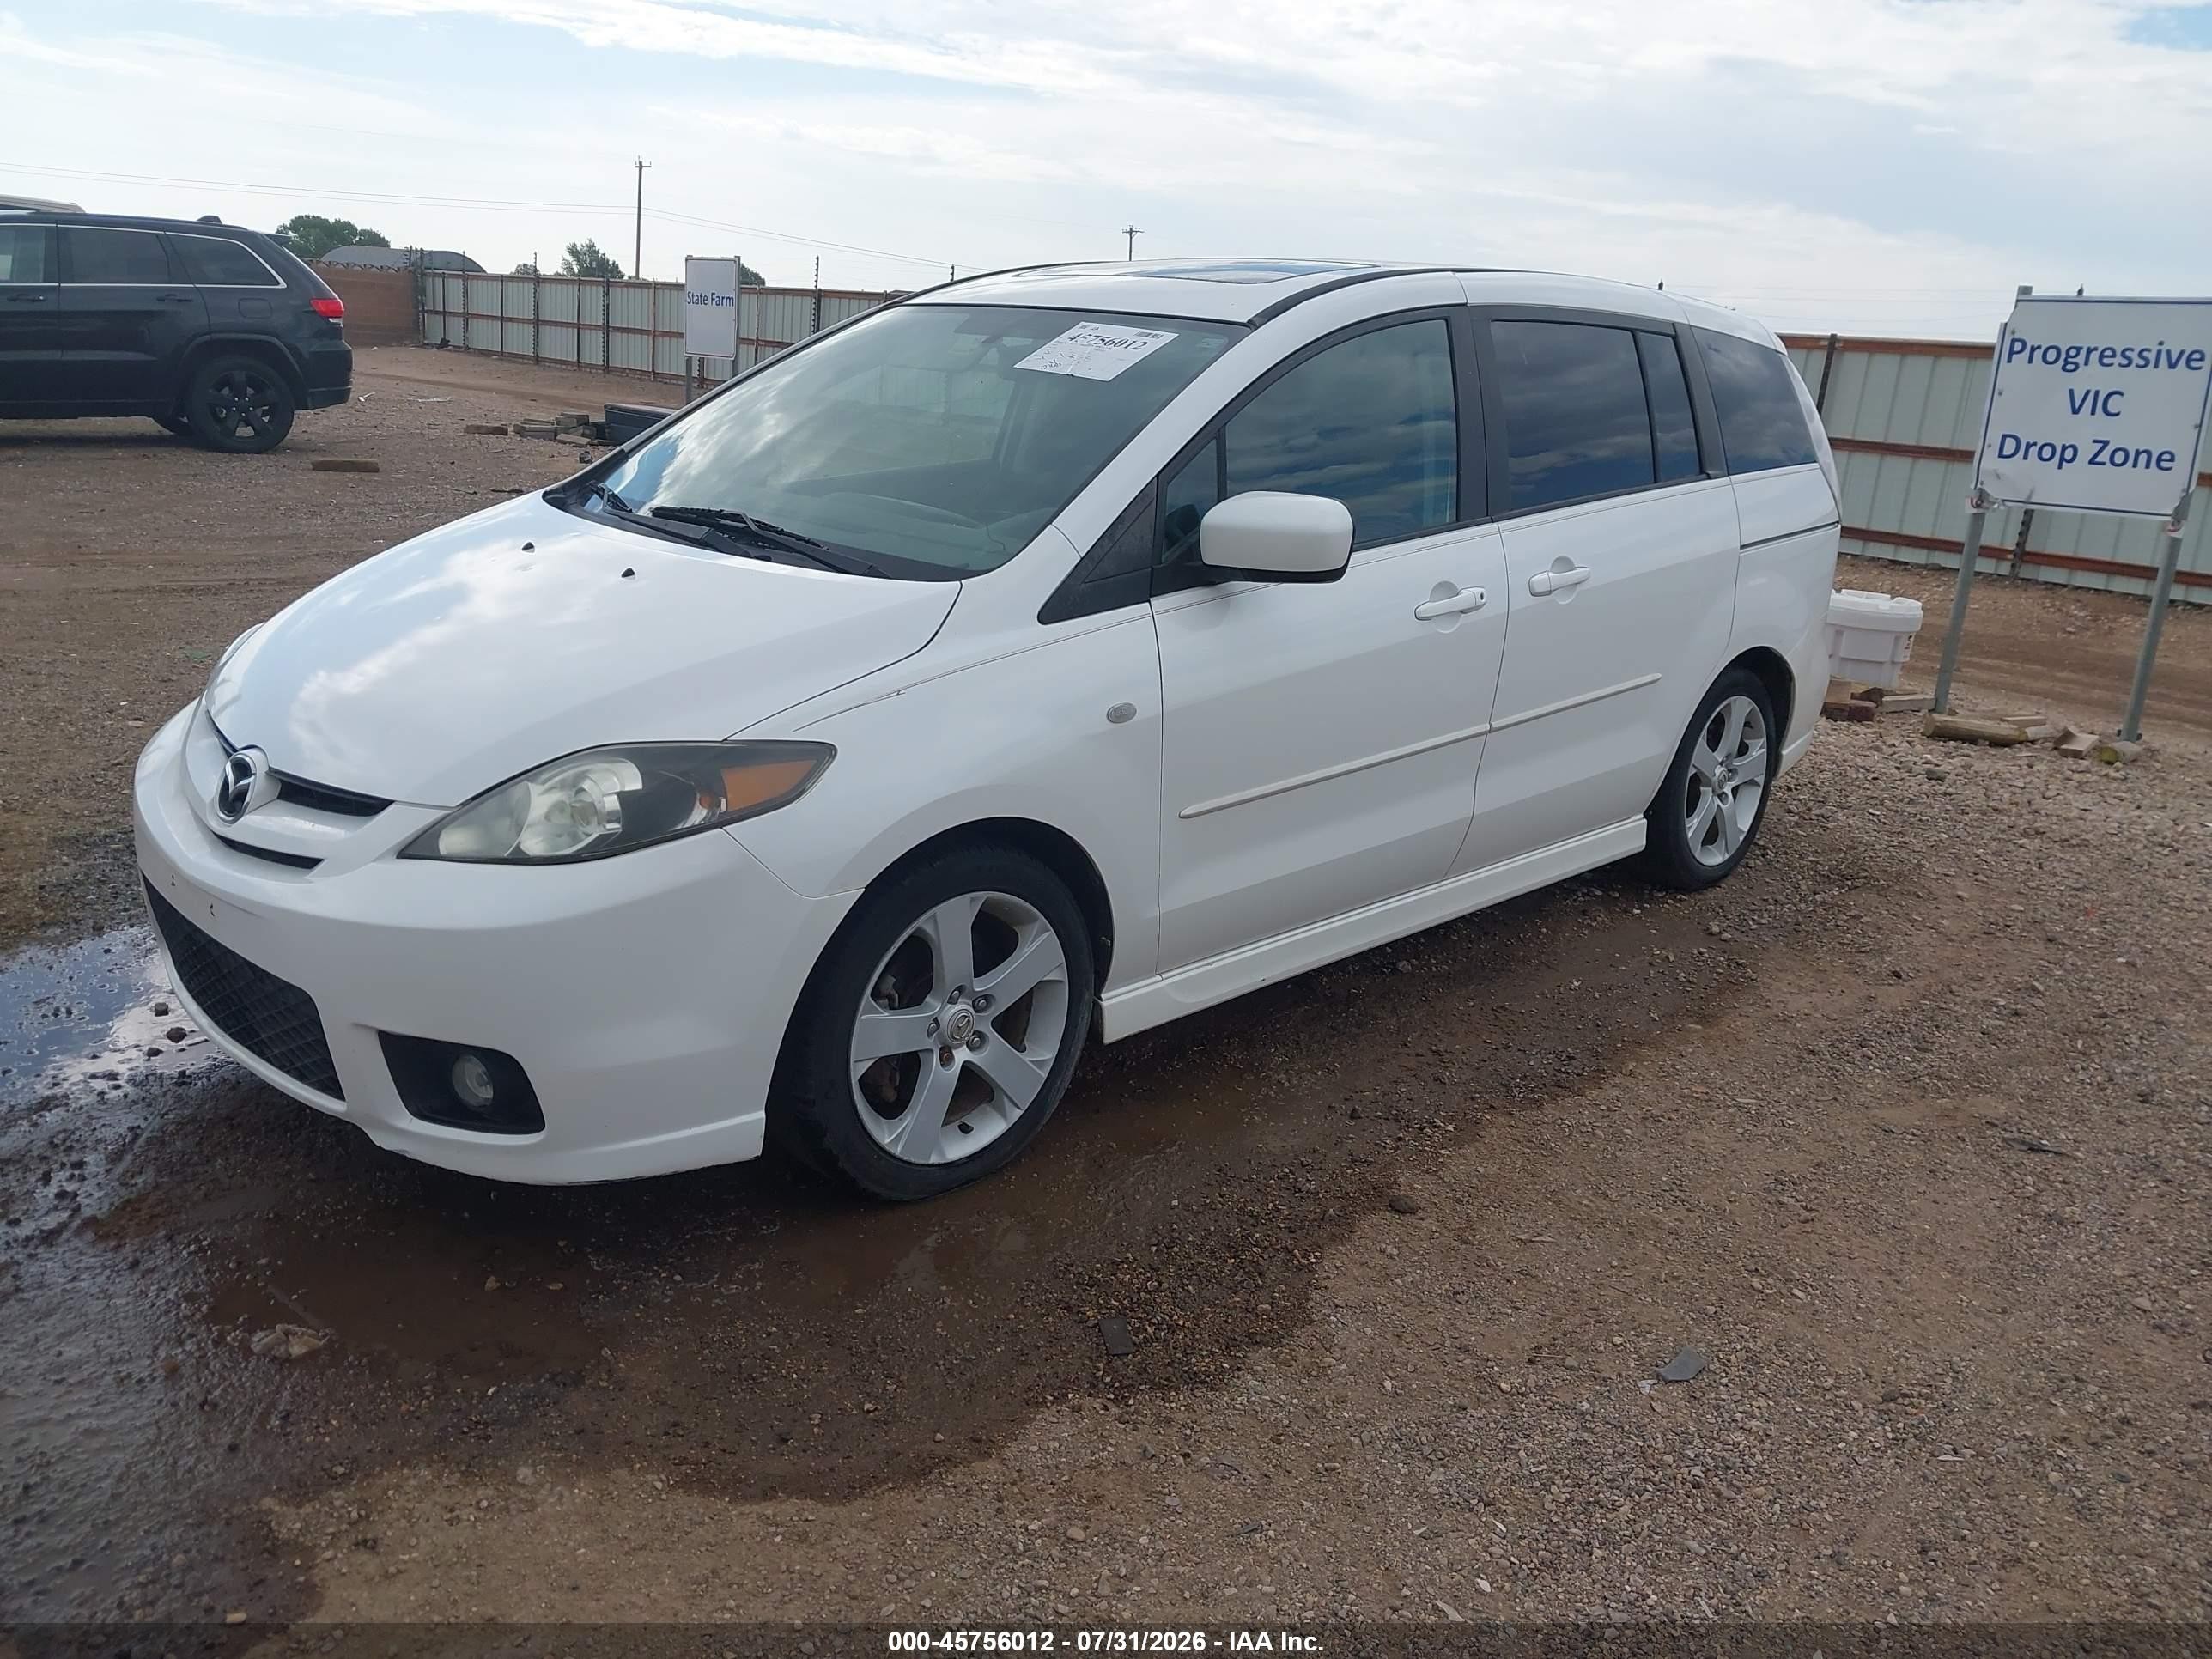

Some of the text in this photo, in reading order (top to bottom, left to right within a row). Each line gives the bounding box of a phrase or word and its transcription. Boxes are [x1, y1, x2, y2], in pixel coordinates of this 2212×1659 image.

[687, 291, 734, 307] State Farm
[2007, 337, 2206, 373] Progressive
[2069, 388, 2124, 417] VIC
[1997, 433, 2176, 471] Drop Zone
